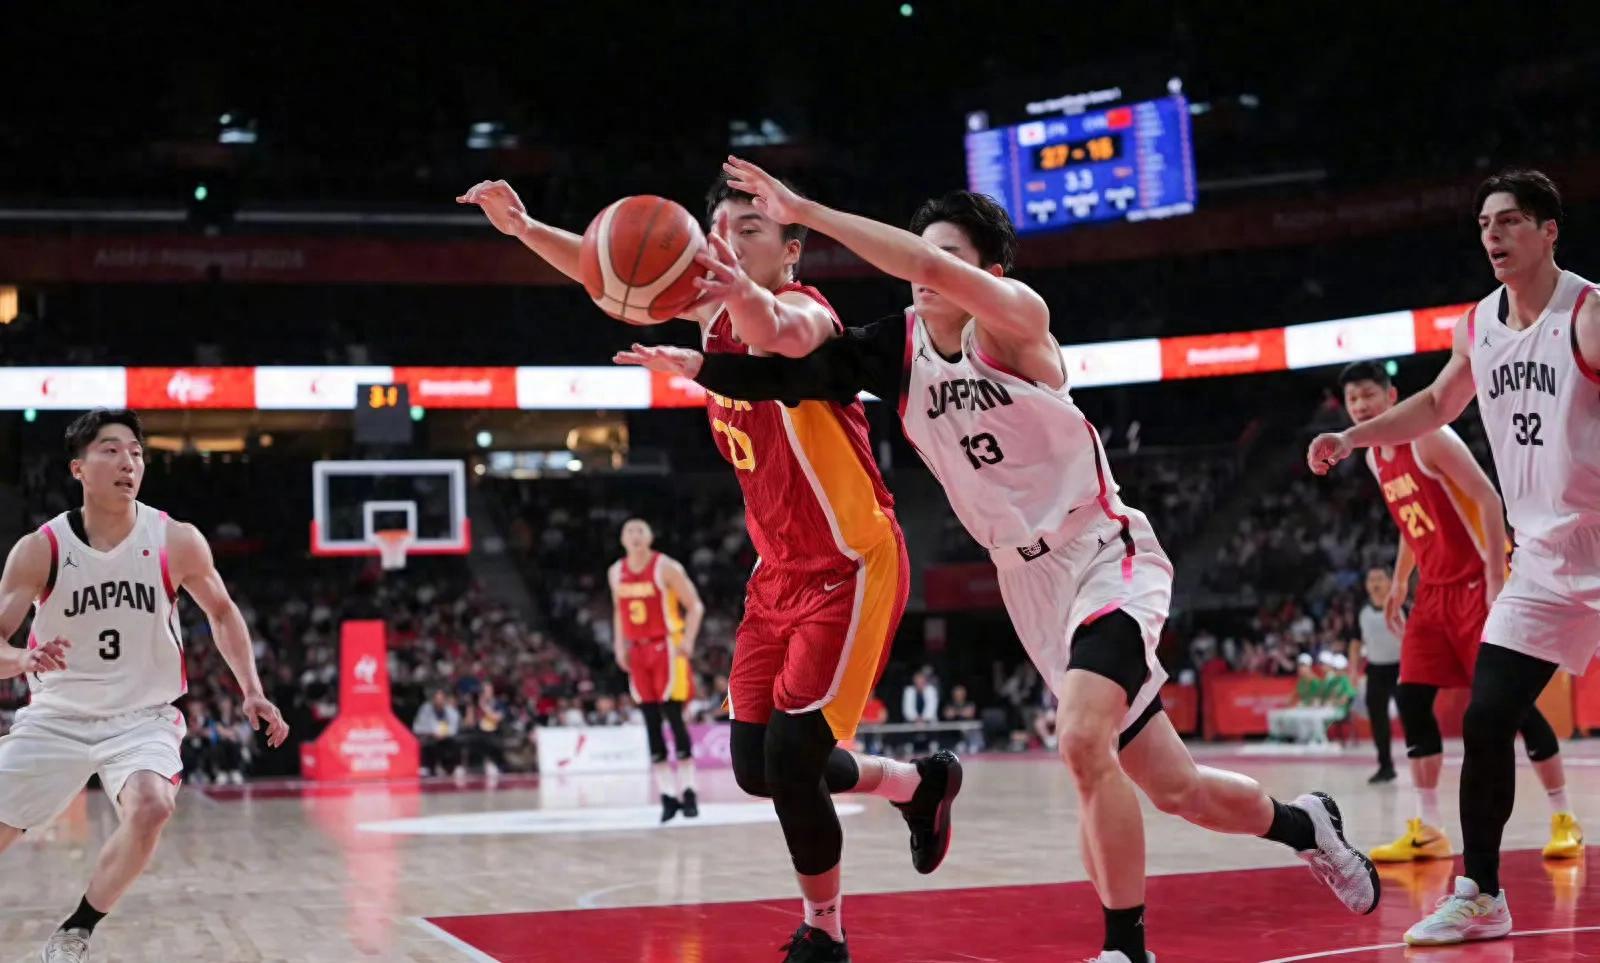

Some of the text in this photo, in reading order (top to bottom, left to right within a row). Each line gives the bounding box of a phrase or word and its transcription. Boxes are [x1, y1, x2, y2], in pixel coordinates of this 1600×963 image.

[1488, 361, 1555, 399] JAPAN
[927, 379, 1014, 419] JAPAN
[1512, 413, 1543, 446] 32
[960, 432, 1004, 470] 13
[1399, 501, 1435, 538] 21
[64, 580, 155, 617] JAPAN
[629, 600, 647, 624] 3
[98, 629, 120, 660] 3
